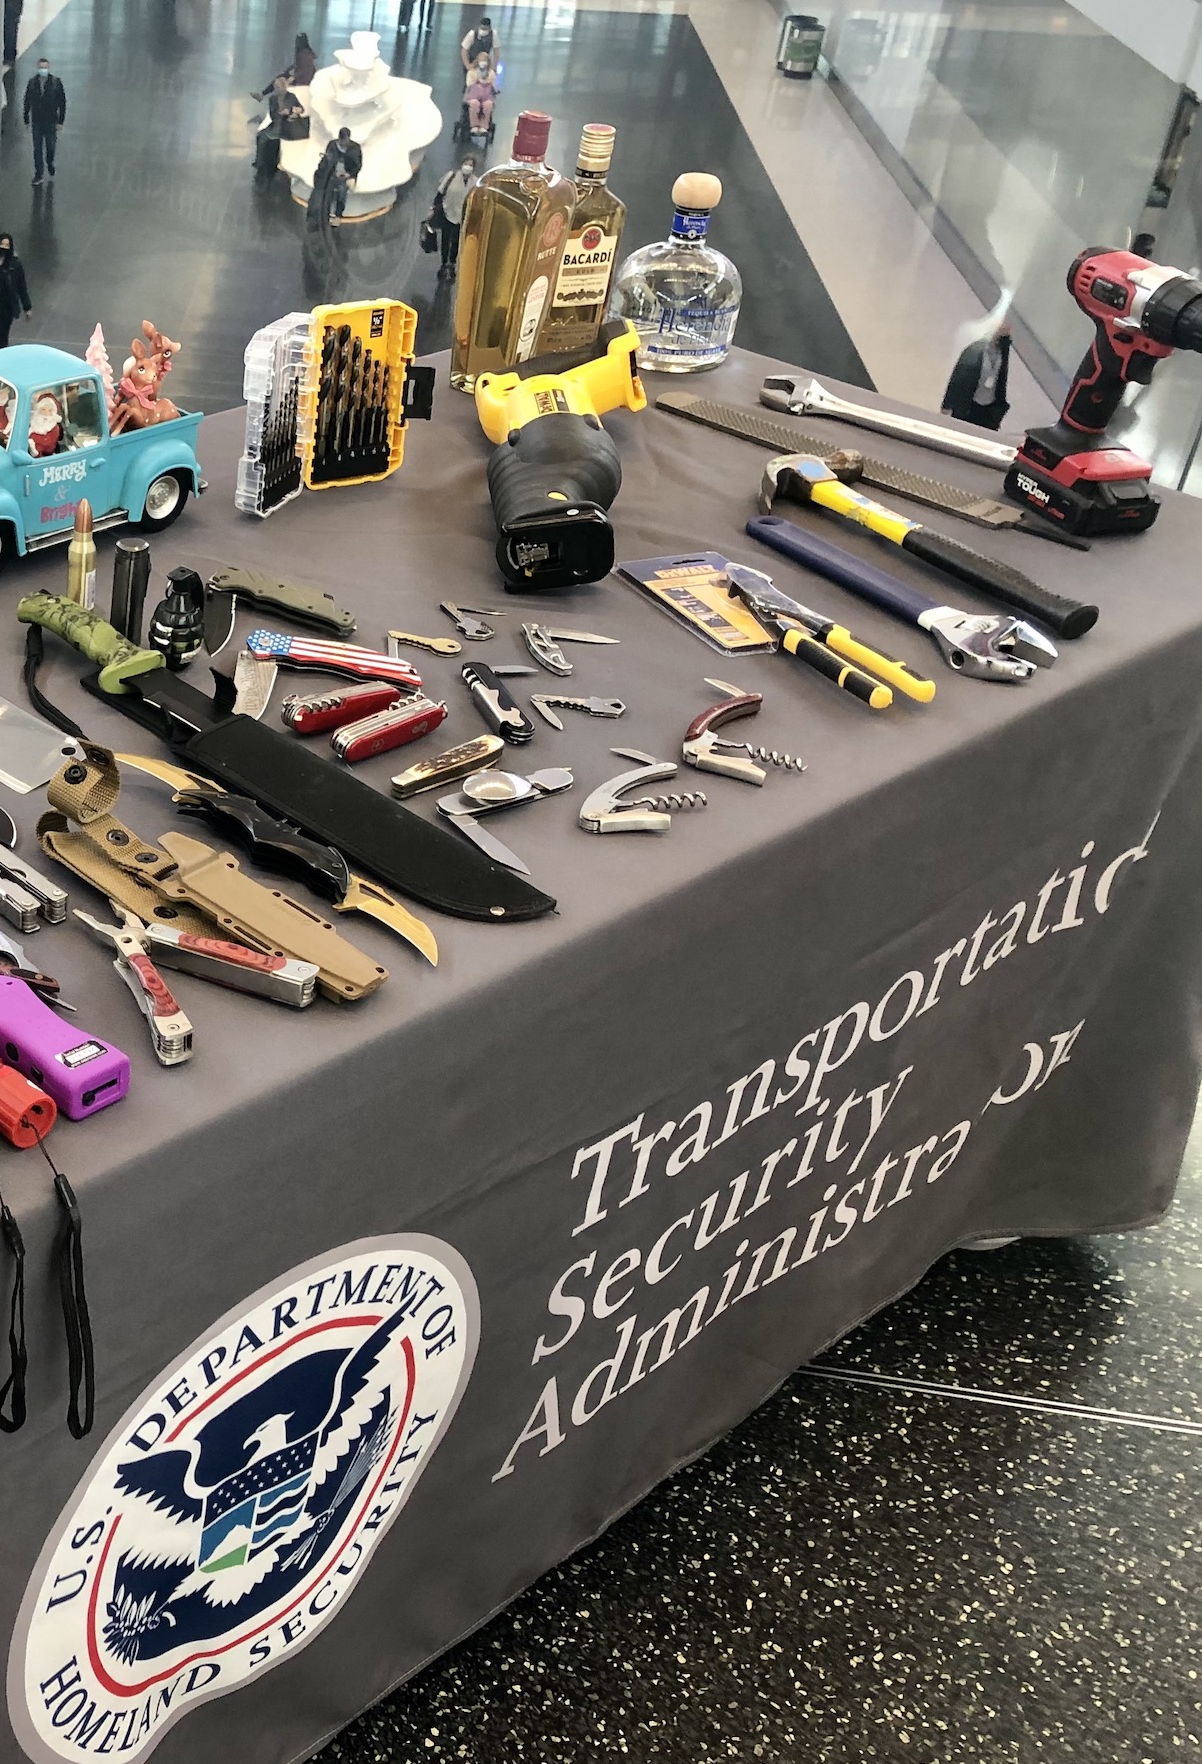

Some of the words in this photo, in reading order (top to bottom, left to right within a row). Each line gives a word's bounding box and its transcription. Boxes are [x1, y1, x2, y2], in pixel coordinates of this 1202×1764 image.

[563, 248, 612, 266] BACARDÍ
[41, 501, 80, 524] Brigh
[1017, 472, 1039, 487] HYPER
[1017, 477, 1050, 504] TOUGH
[571, 809, 1162, 1237] Transportati
[531, 1064, 915, 1366] Security
[46, 1505, 113, 1614] U.S.
[125, 1263, 446, 1453] DEPARTMENT
[421, 1303, 457, 1361] OF
[39, 1655, 222, 1754] HOMELAND
[249, 1408, 439, 1668] SECURITY
